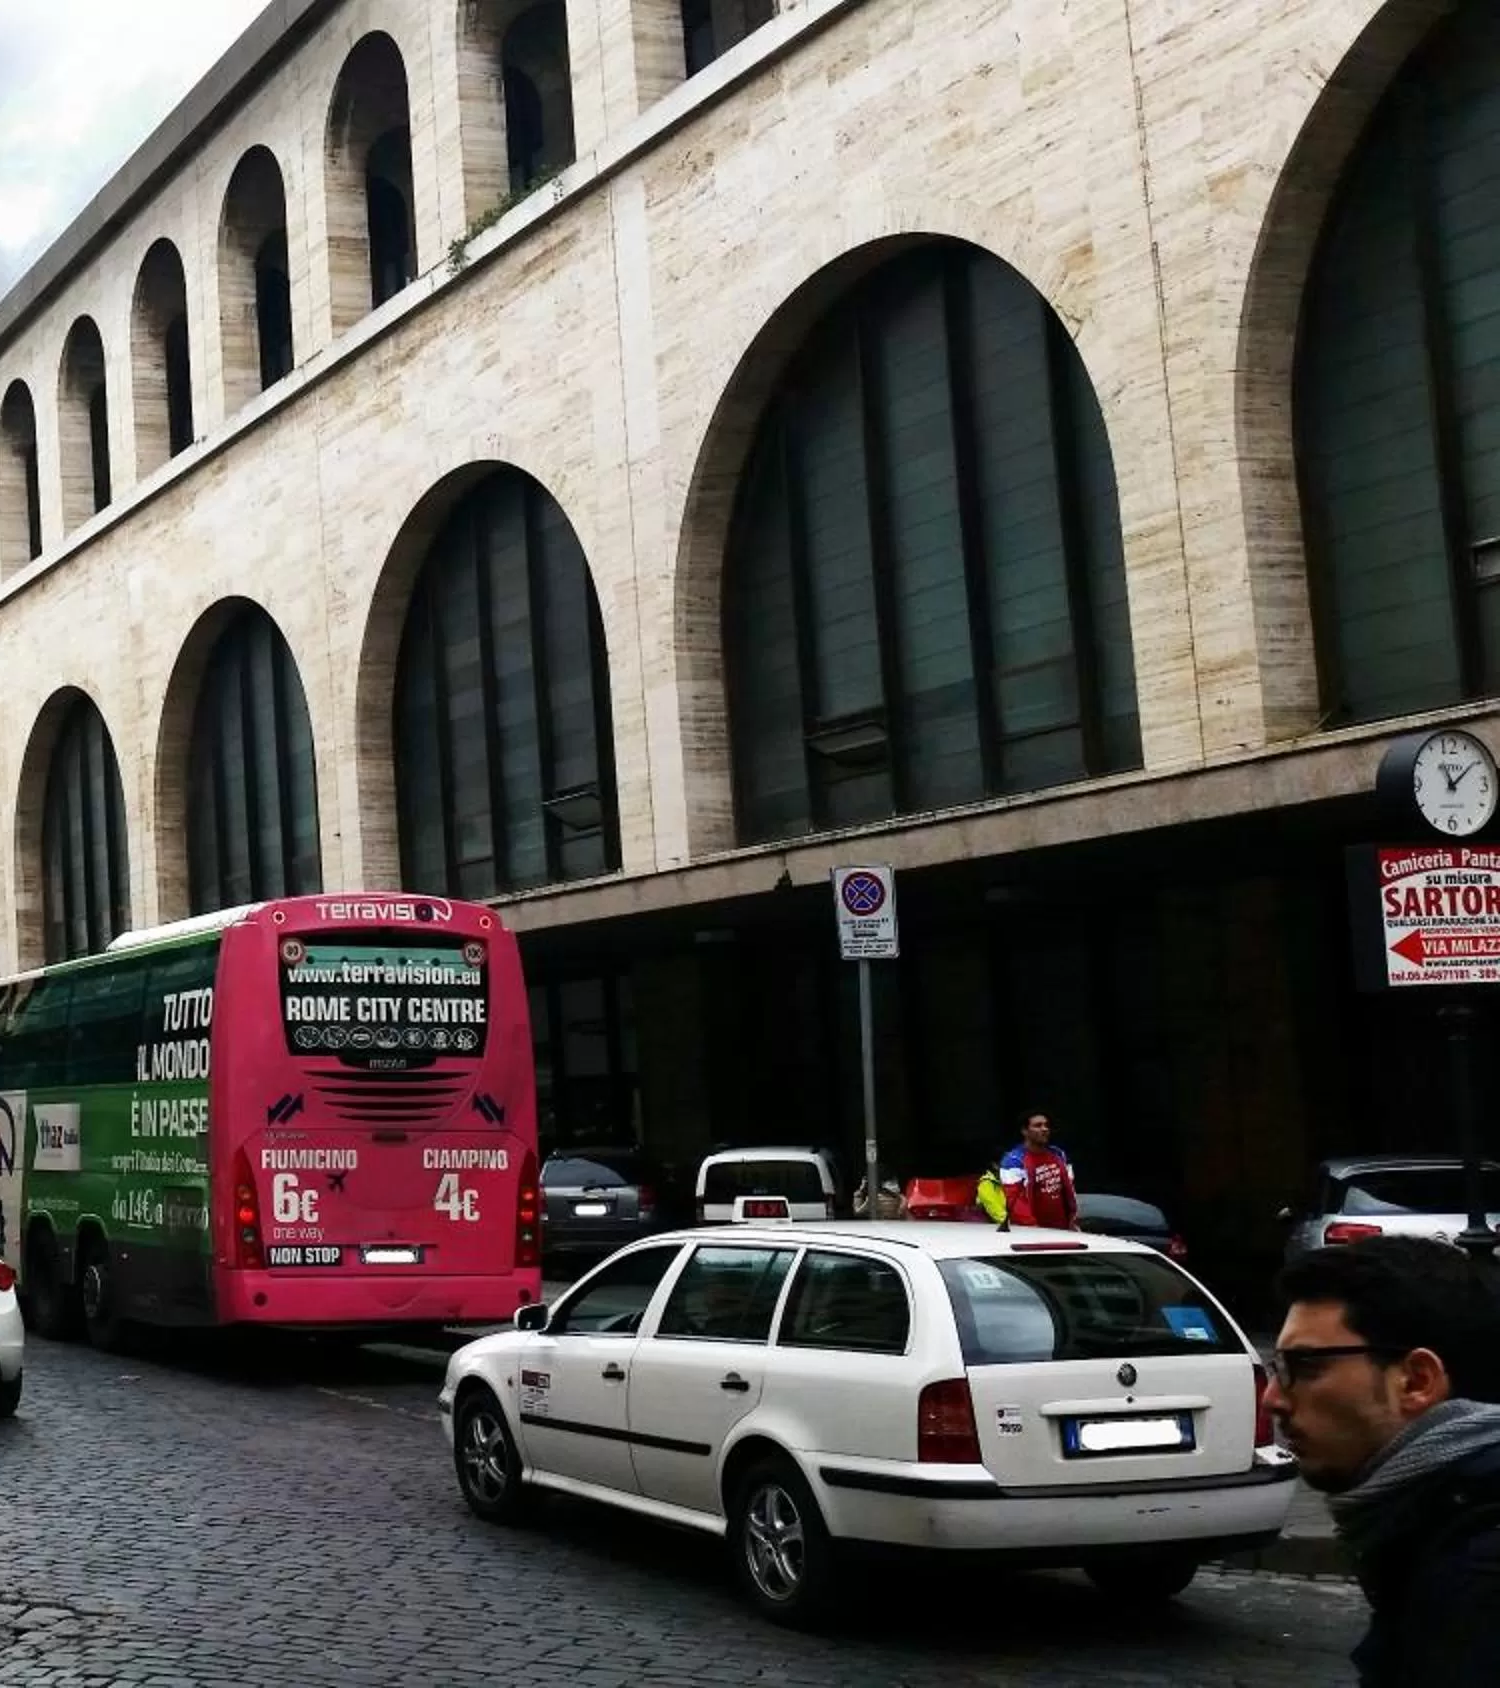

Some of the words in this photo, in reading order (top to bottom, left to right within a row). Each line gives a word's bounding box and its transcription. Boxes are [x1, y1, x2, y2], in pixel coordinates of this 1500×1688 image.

[1441, 738, 1458, 755] 12
[1447, 815, 1458, 831] 6
[1381, 849, 1453, 878] Camiceria
[1425, 873, 1442, 885] su
[1445, 870, 1492, 885] misura
[1384, 885, 1500, 918] SARTOR
[1422, 939, 1449, 955] VIA
[287, 960, 481, 986] www.terravision.eu
[163, 987, 213, 1032] TUTTO
[286, 995, 351, 1021] ROME
[357, 997, 402, 1023] CITY
[407, 998, 487, 1024] CENTRE
[137, 1043, 149, 1082] IL
[152, 1037, 211, 1081] MONDO
[141, 1099, 157, 1138] IN
[159, 1098, 209, 1138] PAESE
[261, 1148, 358, 1170] FIUMICINO
[423, 1148, 509, 1170] CIAMPINO
[272, 1172, 319, 1223] 6€
[433, 1173, 480, 1222] 4€
[273, 1228, 297, 1240] one
[299, 1227, 325, 1243] way
[270, 1247, 301, 1264] NON
[305, 1247, 341, 1264] STOP
